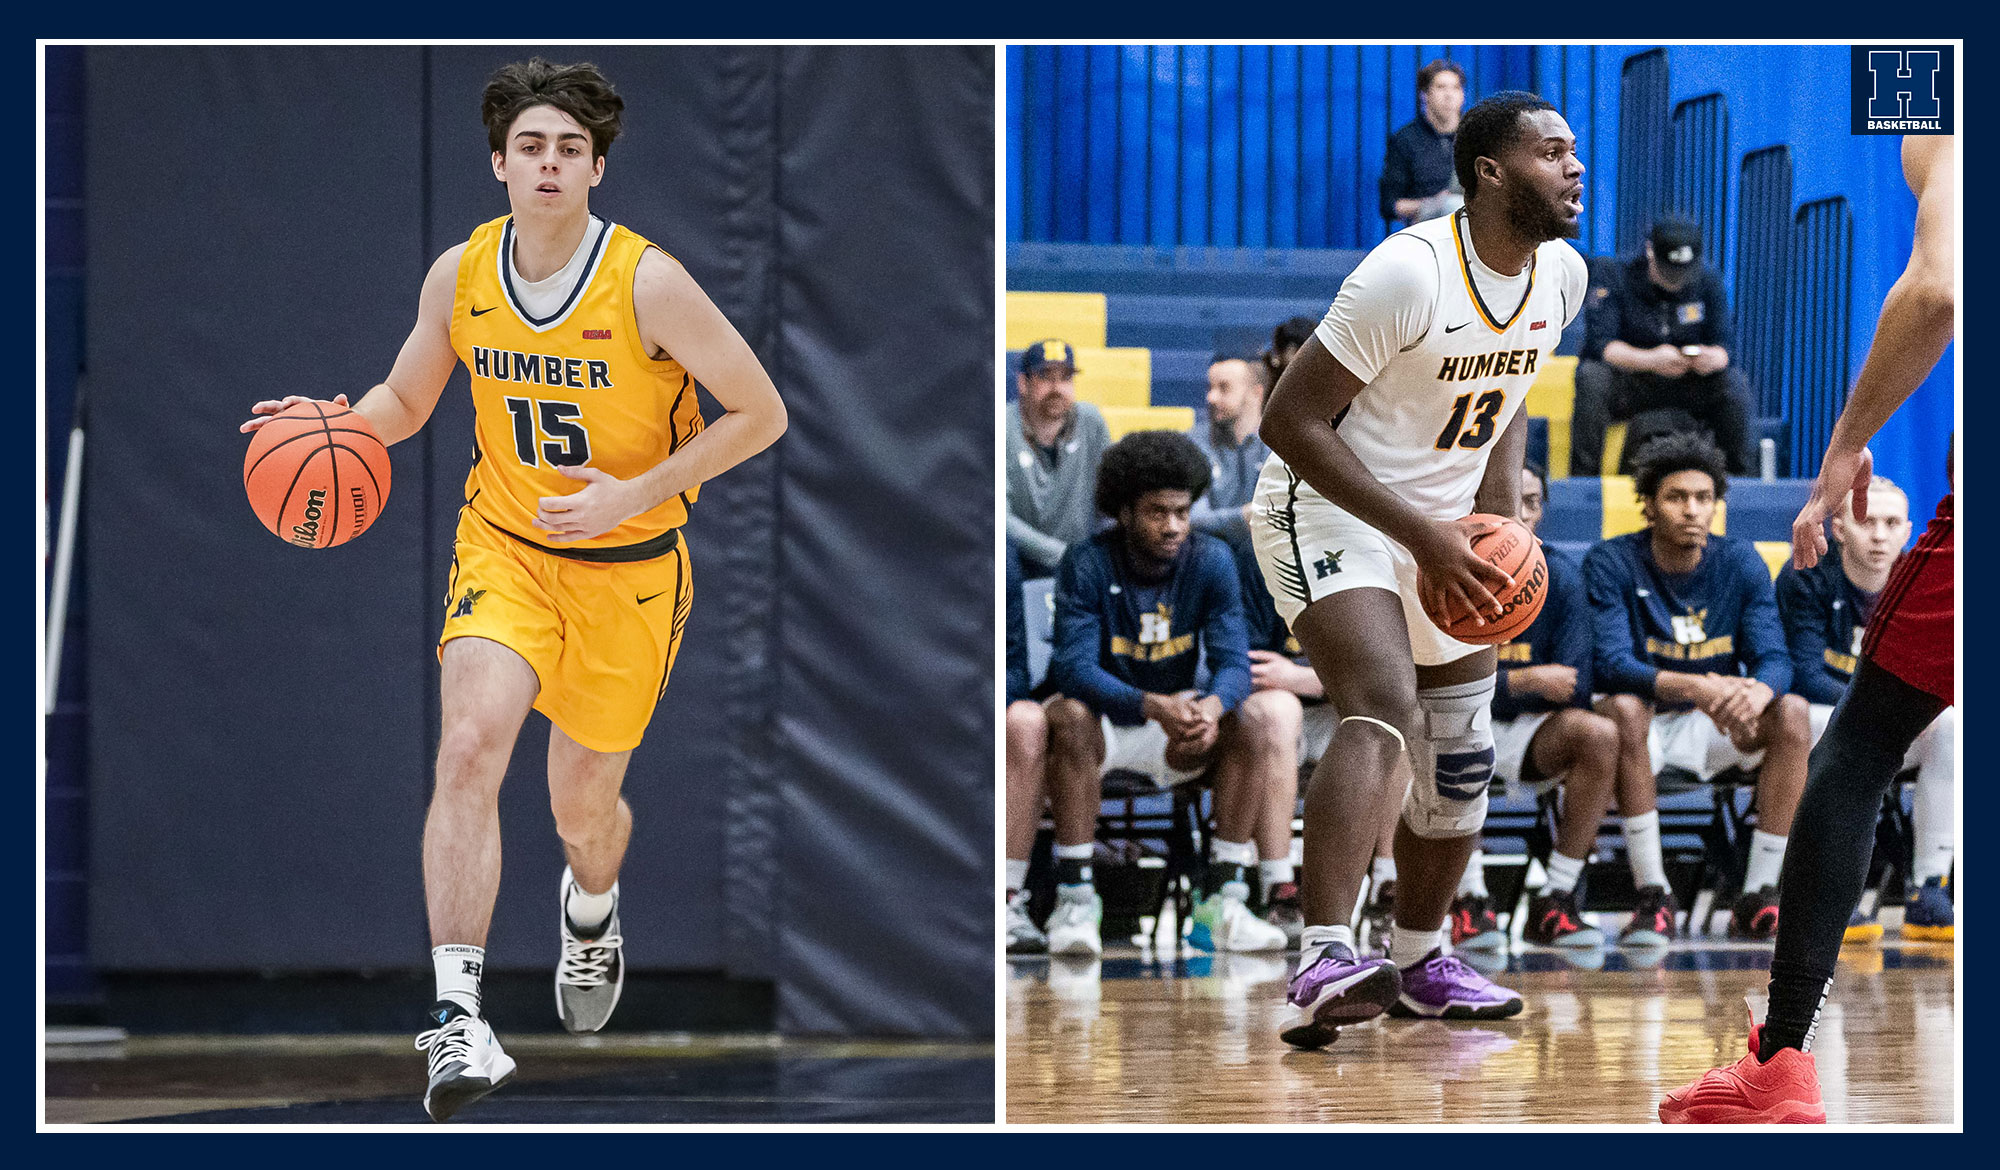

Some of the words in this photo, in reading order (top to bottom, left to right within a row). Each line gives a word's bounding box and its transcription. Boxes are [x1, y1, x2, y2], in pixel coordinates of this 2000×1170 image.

[472, 345, 614, 389] HUMBER
[1437, 348, 1538, 381] HUMBER
[503, 395, 592, 469] 15
[1434, 388, 1507, 451] 13
[462, 960, 481, 977] H
